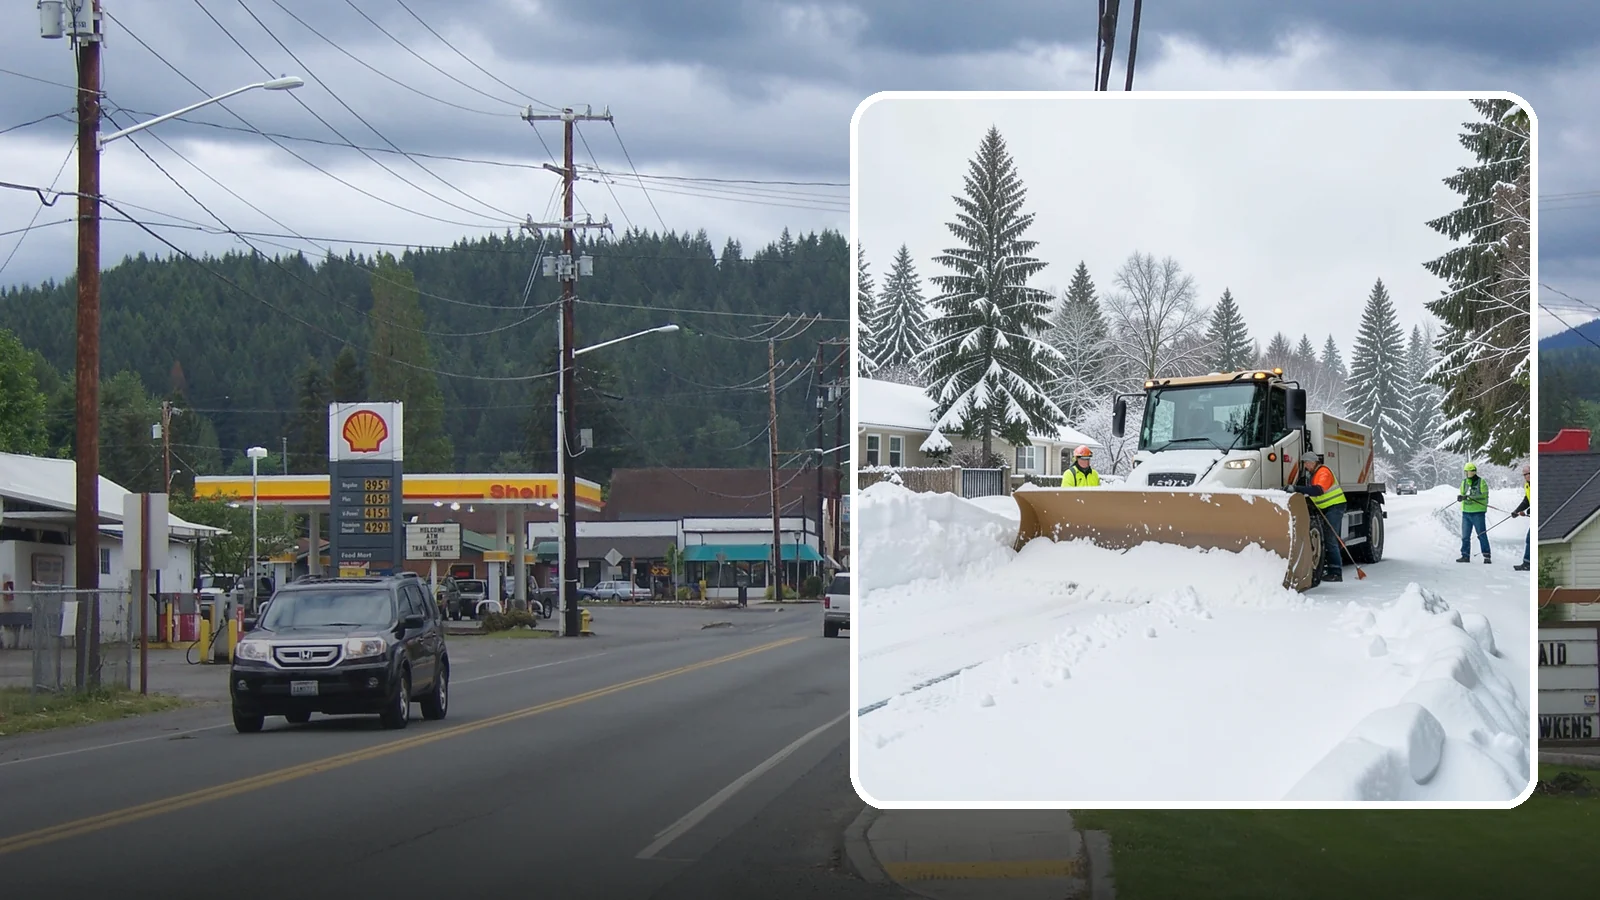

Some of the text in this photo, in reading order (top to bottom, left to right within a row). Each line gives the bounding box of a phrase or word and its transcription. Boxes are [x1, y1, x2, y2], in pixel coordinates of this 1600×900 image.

[366, 480, 383, 490] 395
[490, 484, 547, 499] Shell
[366, 494, 383, 504] 405
[366, 508, 383, 518] 415
[366, 522, 383, 533] 429
